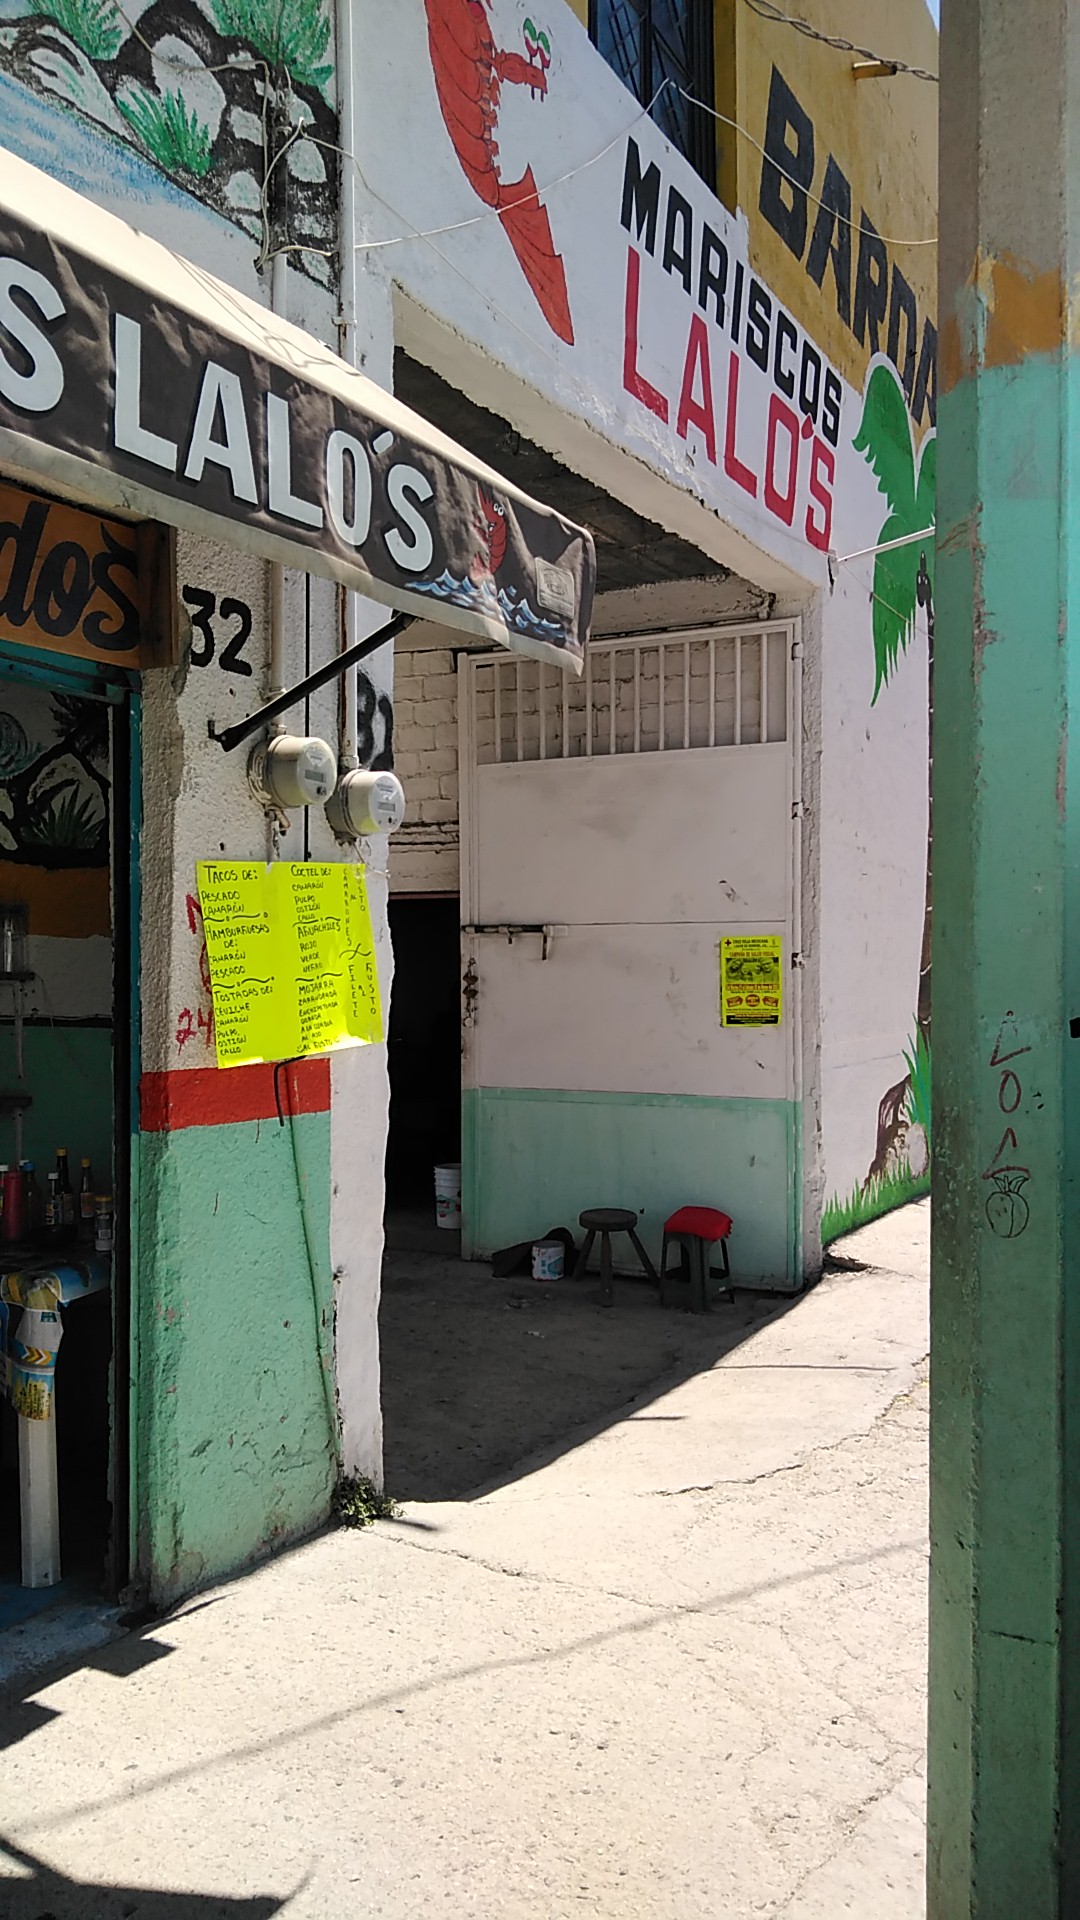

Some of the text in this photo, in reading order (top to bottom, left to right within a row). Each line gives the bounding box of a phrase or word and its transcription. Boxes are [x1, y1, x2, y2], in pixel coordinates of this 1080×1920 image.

[620, 135, 842, 448] MARISCOS
[622, 245, 836, 552] LALO'S
[114, 312, 434, 573] LALO'S
[182, 585, 252, 677] 32
[203, 865, 258, 884] TACOS DE:
[291, 864, 332, 877] COCTEL DE:
[201, 890, 240, 903] PESCADO
[294, 895, 315, 905] PULPO
[204, 902, 245, 917] CAMARÓN
[343, 868, 352, 946] CAMARONES
[297, 913, 315, 922] CALLO
[205, 923, 270, 941] HAMBURGUESAS
[223, 938, 238, 949] DE:
[299, 940, 318, 952] ROJO
[300, 951, 320, 963] VERDE
[210, 965, 246, 979] PESCADO
[213, 985, 274, 1002] TOSTADAS DE:
[298, 979, 334, 996] MOJARRA
[348, 964, 359, 1018] FILETE
[365, 962, 377, 1015] GUSTO
[214, 1002, 251, 1018] CEVICHE
[220, 1046, 242, 1056] CALLO
